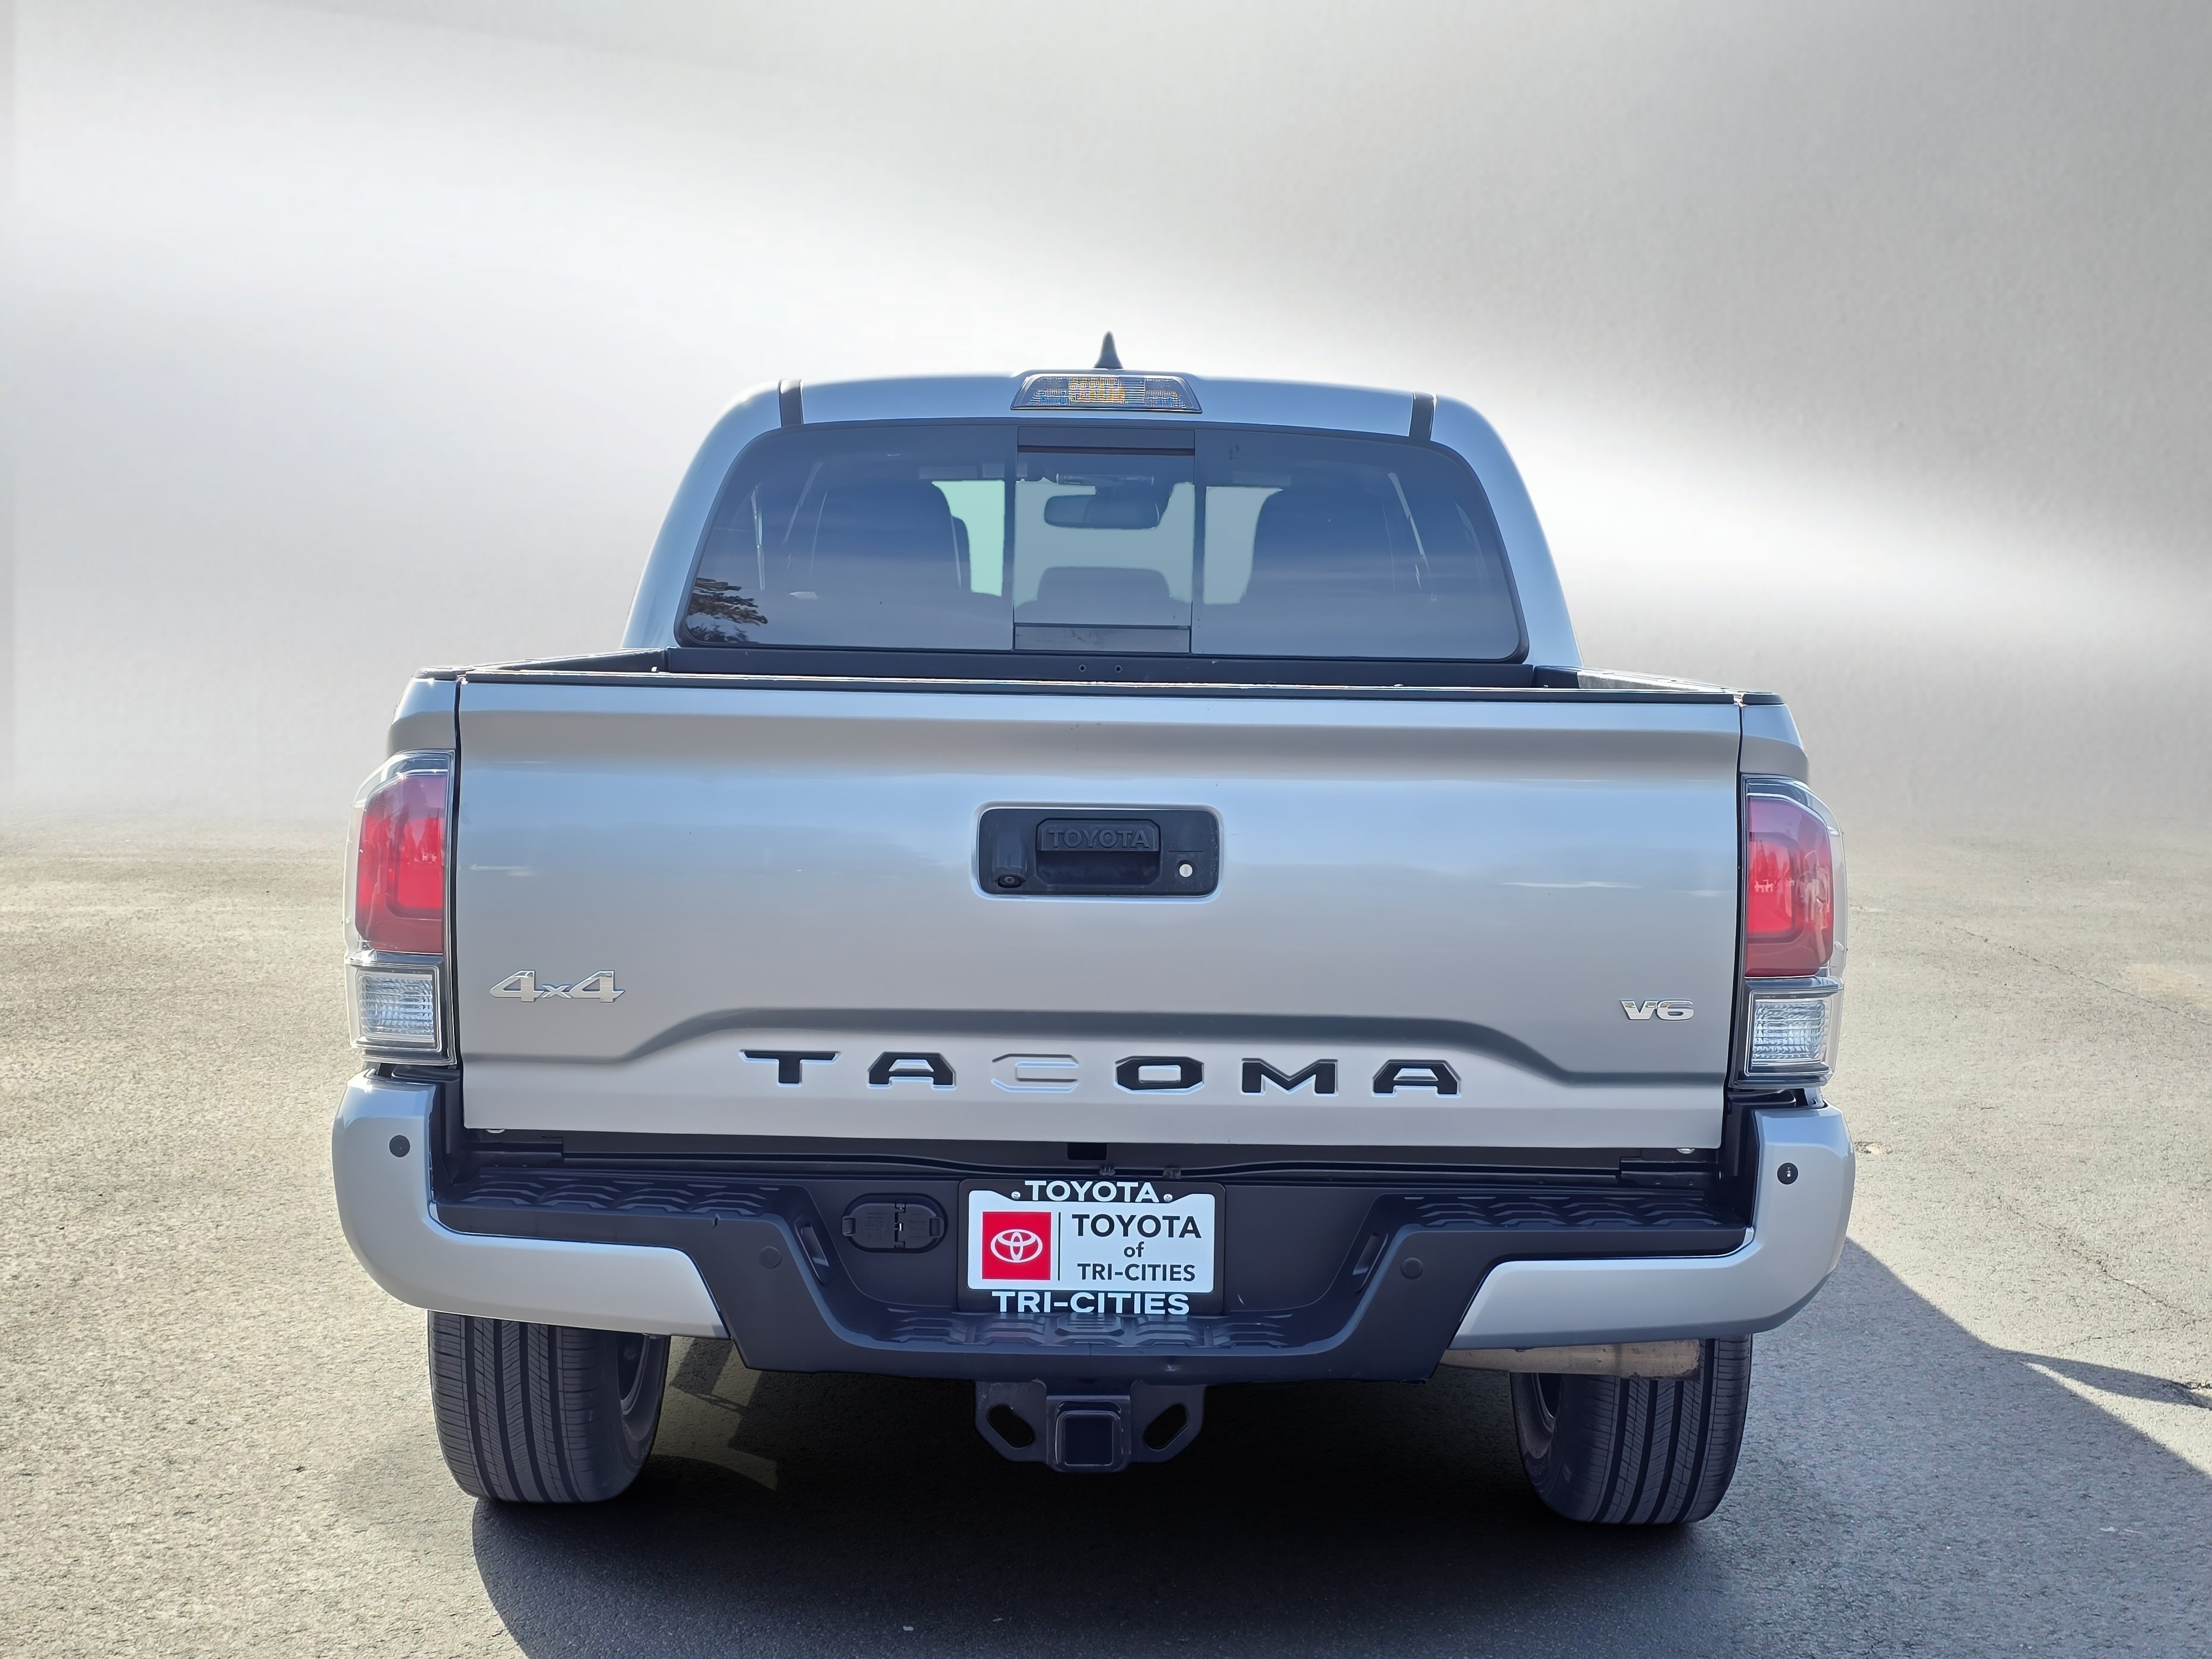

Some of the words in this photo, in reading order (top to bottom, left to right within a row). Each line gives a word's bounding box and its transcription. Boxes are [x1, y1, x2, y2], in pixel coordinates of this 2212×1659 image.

[1048, 829, 1150, 849] TOYOTA
[1620, 999, 1694, 1020] V6
[739, 1050, 1461, 1097] TACOMA
[1025, 1180, 1159, 1203] TOYOTA
[1072, 1214, 1202, 1239] TOYOTA
[1123, 1241, 1144, 1258] of
[1077, 1263, 1196, 1282] TRI-CITIES
[992, 1291, 1190, 1315] TRI-CITIES
